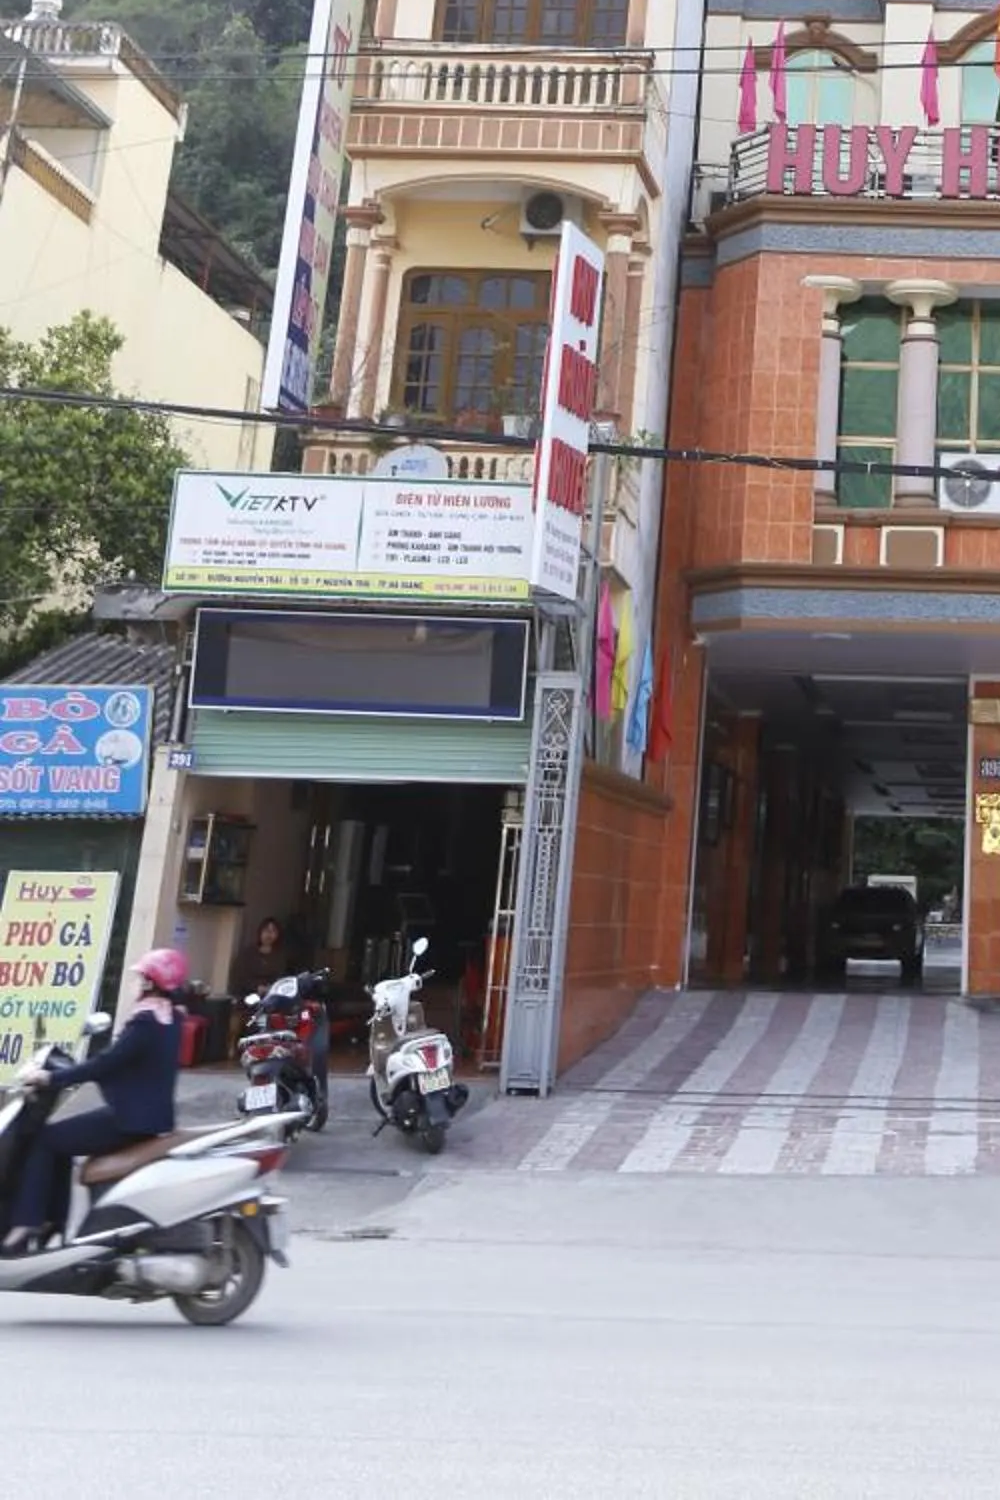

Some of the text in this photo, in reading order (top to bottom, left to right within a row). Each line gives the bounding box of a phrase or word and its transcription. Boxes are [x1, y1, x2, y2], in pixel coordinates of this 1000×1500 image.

[766, 123, 918, 197] HUY
[19, 882, 64, 903] Huy
[5, 911, 57, 946] PHỞ
